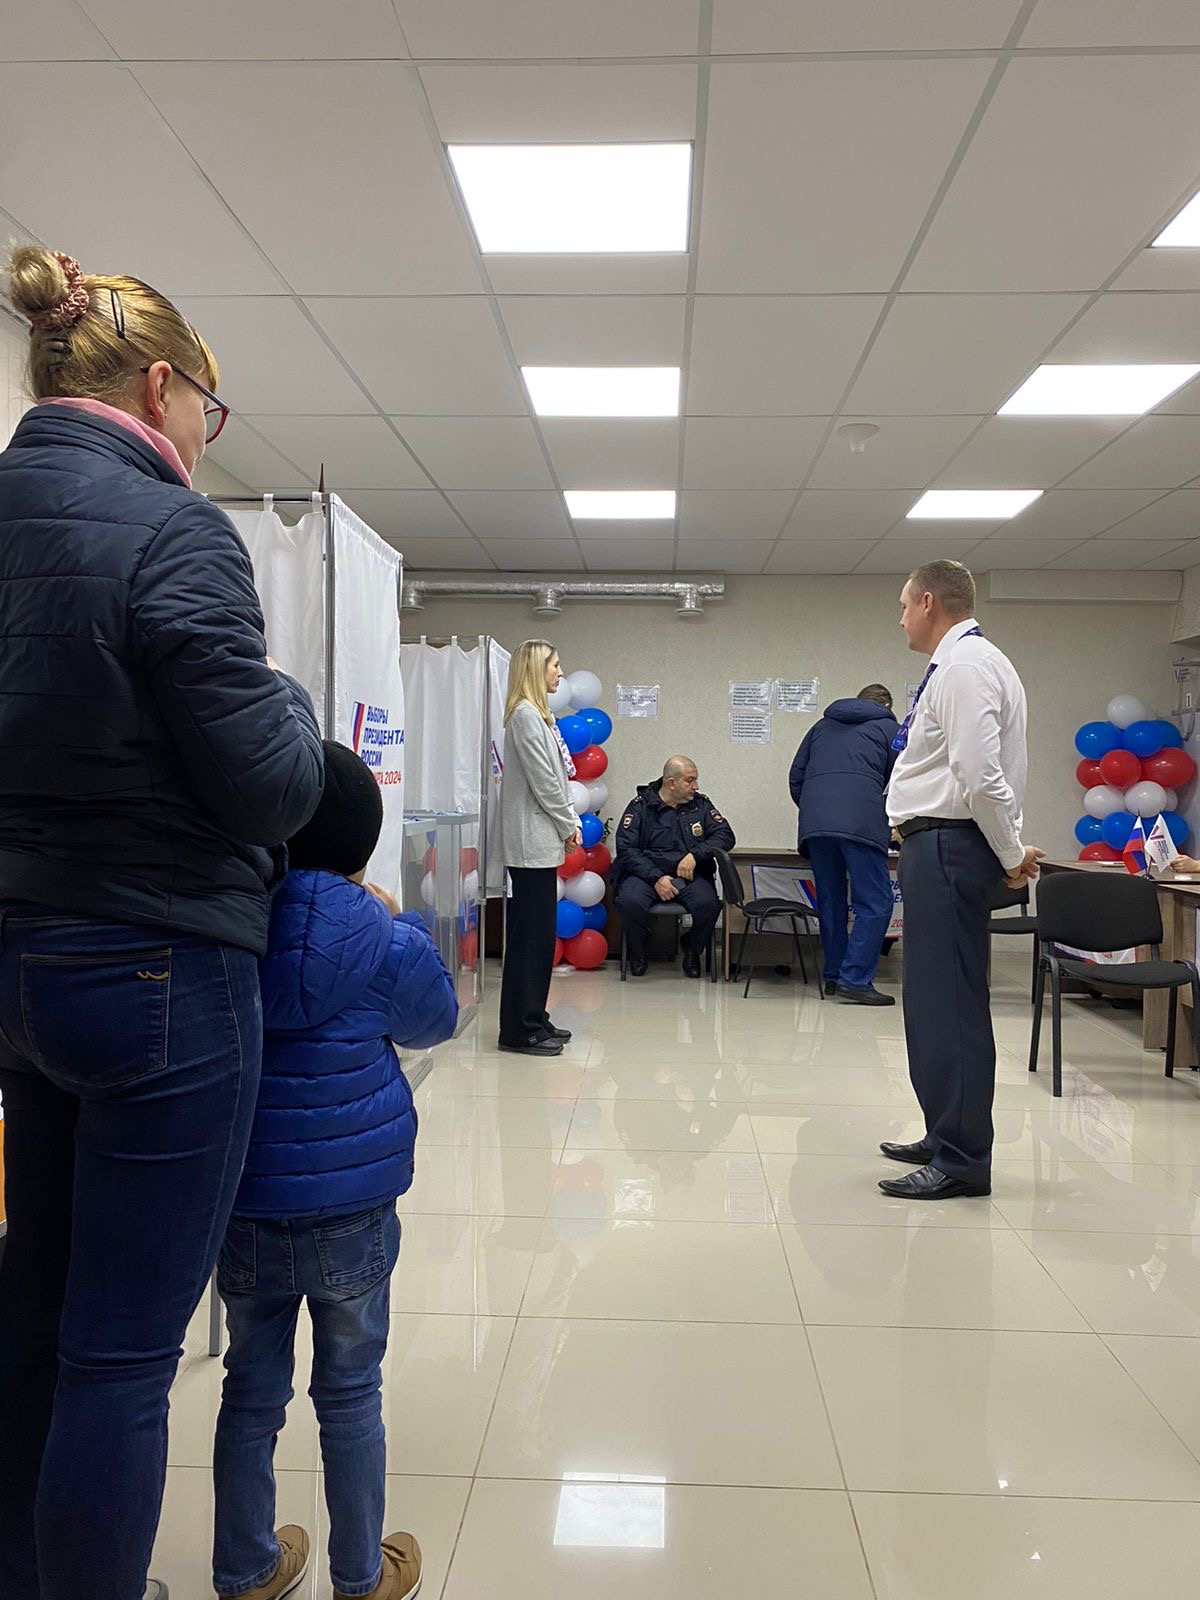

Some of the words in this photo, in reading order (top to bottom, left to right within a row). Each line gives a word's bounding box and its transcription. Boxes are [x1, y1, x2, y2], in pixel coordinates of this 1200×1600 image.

[366, 705, 388, 724] ВЫБОРЫ
[363, 728, 404, 747] ПРЕЗИДЕНТА
[384, 770, 401, 785] 2024
